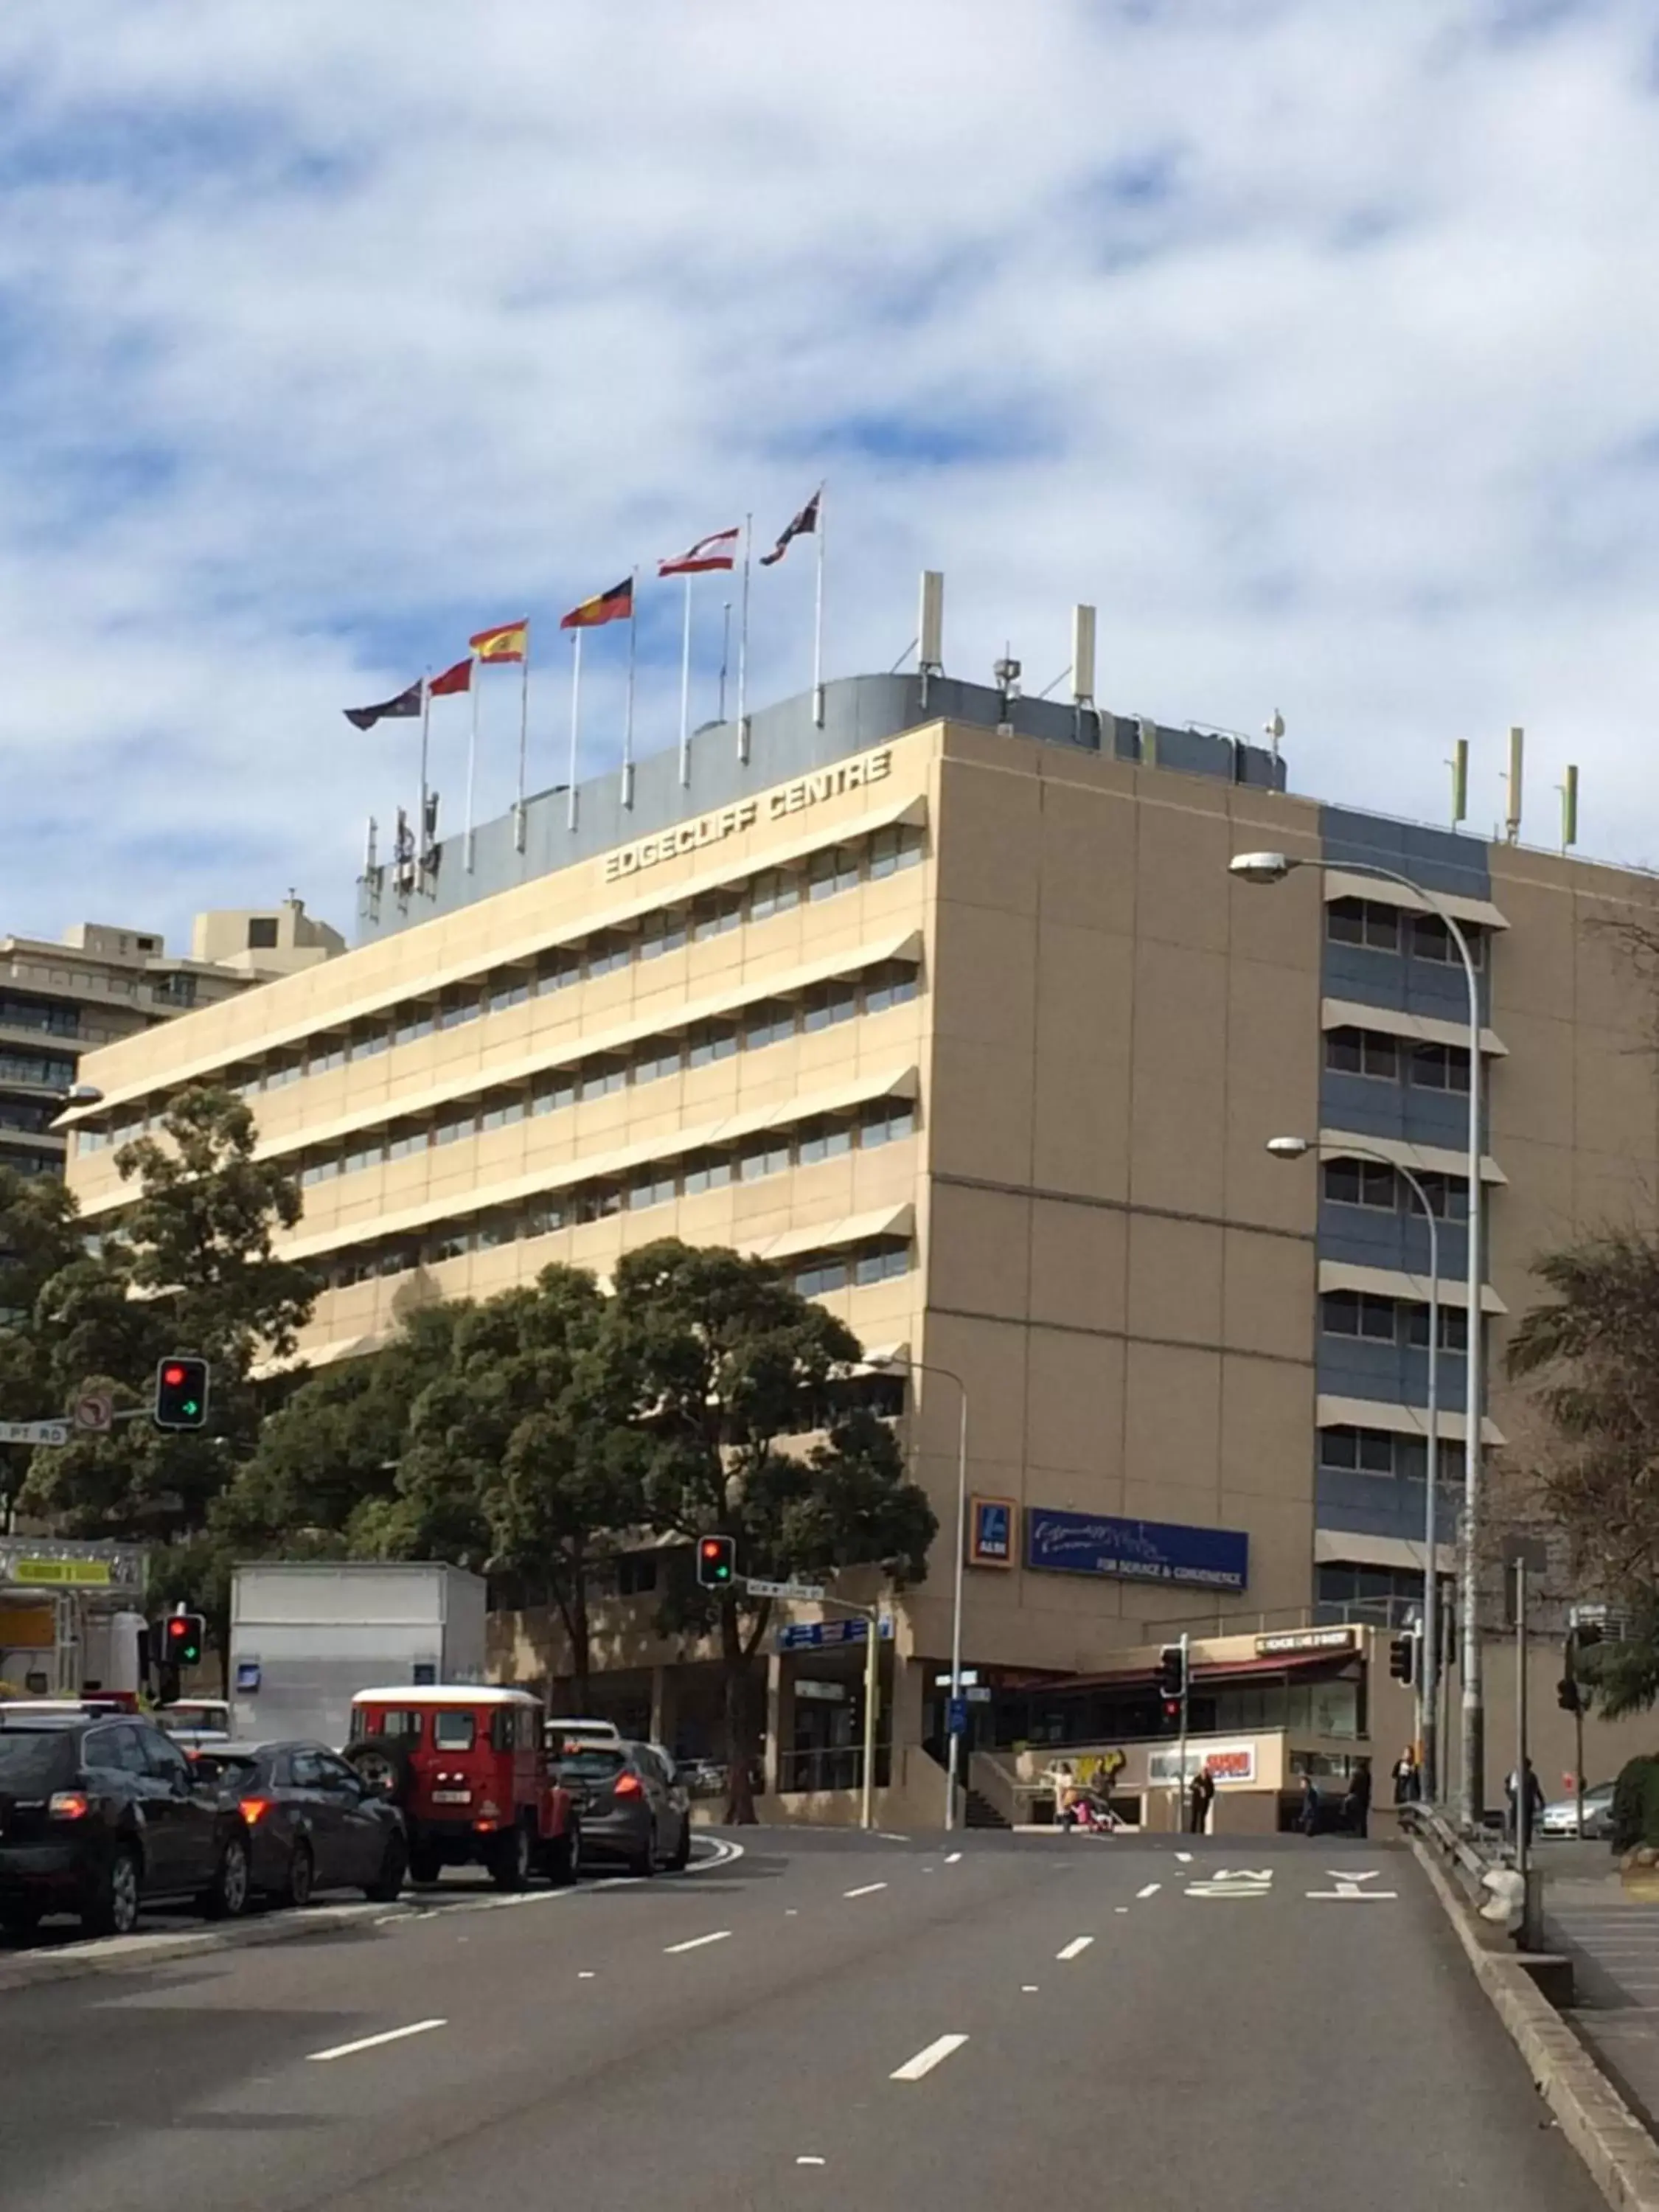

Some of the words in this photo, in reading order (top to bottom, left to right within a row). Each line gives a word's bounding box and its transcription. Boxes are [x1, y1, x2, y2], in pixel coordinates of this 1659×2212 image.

[605, 801, 758, 883] EDGECLIFF
[769, 750, 892, 820] CENTRE
[10, 1427, 29, 1440] PT
[40, 1427, 61, 1441] RD
[1119, 1559, 1161, 1576] SERVICE
[1173, 1566, 1242, 1585] CONVENIENCE
